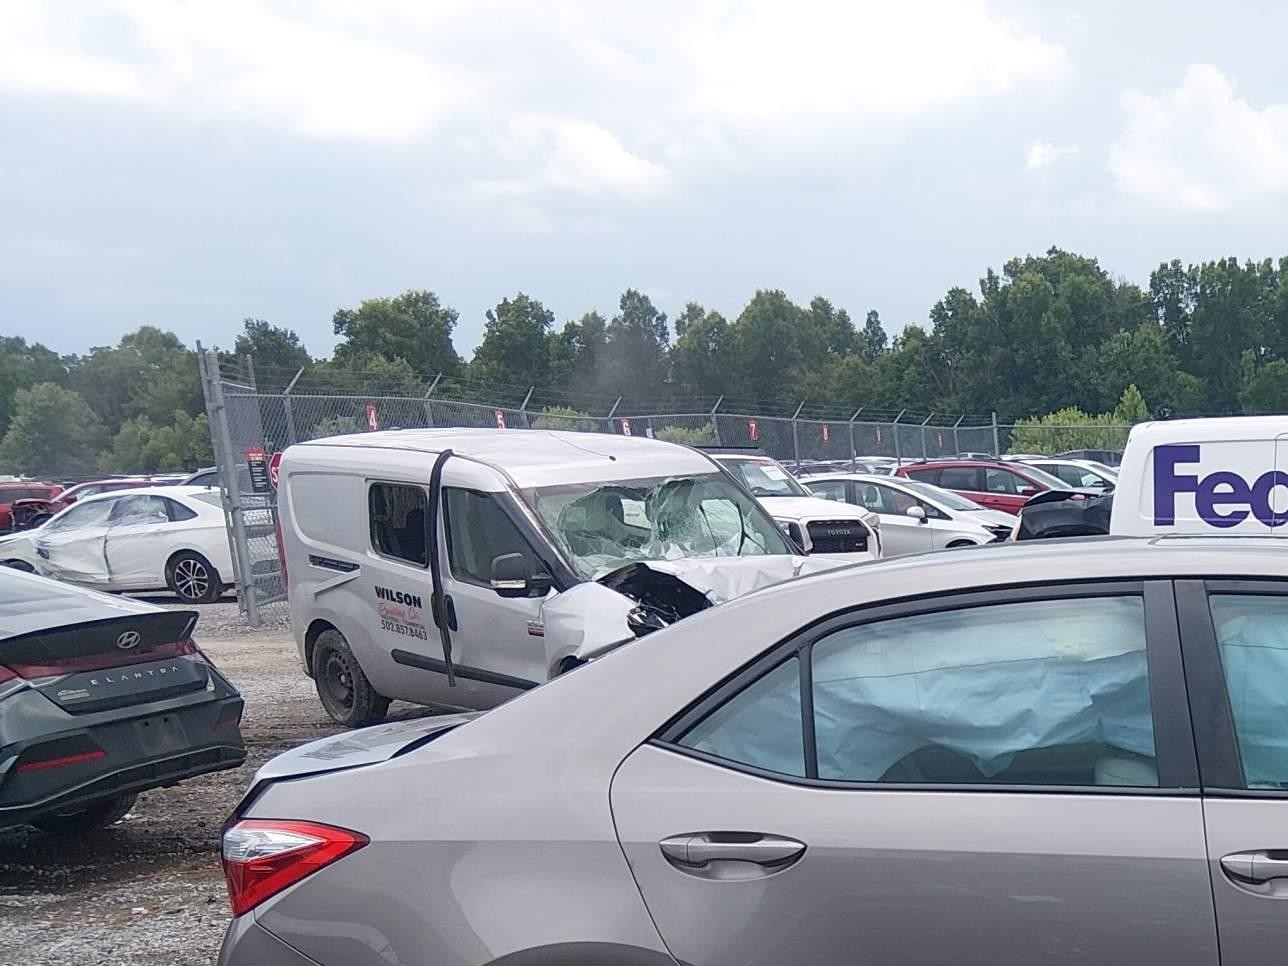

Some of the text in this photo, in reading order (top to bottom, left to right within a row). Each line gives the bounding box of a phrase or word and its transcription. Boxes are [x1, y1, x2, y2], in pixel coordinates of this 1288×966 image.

[369, 410, 377, 430] 4
[623, 421, 631, 436] 6
[374, 585, 423, 609] WILSON
[90, 666, 178, 685] ELANTRA
